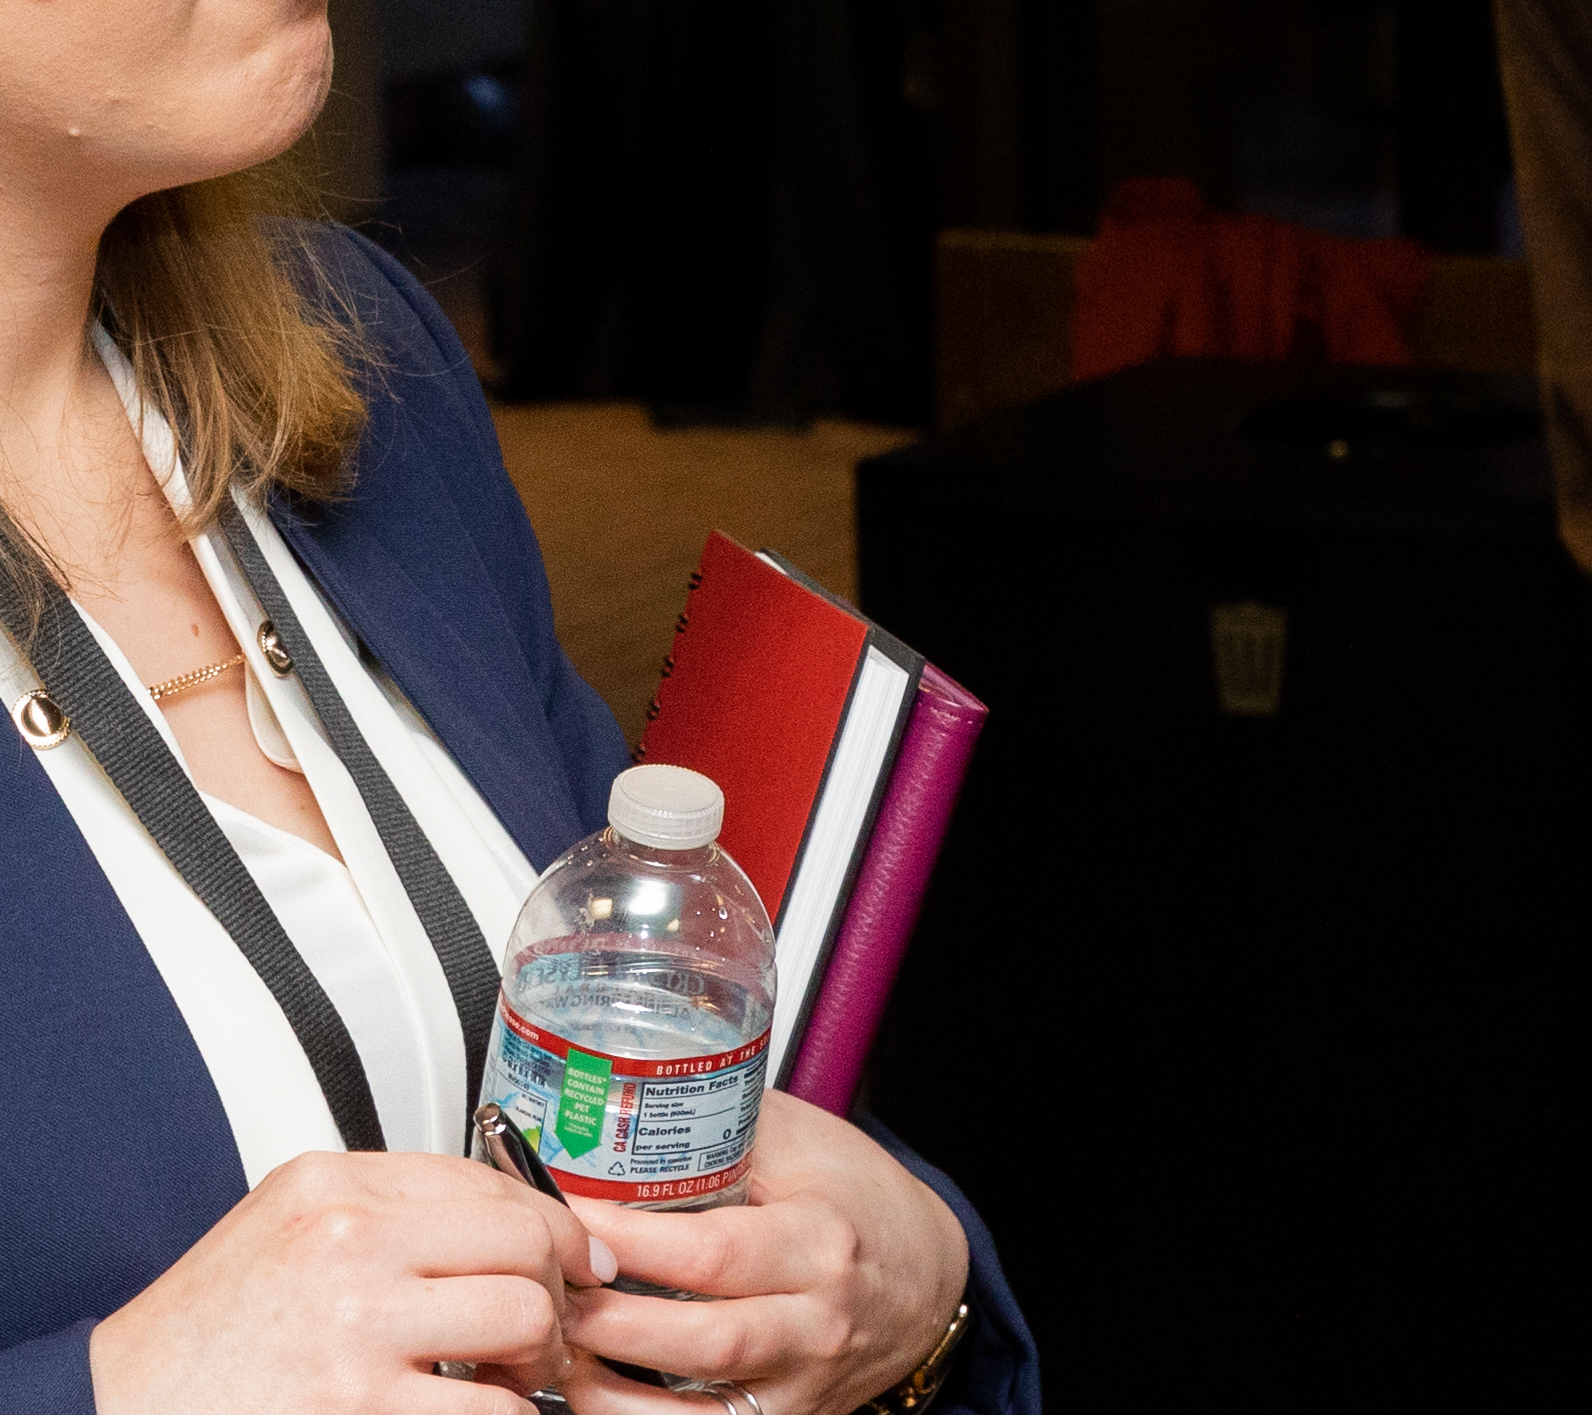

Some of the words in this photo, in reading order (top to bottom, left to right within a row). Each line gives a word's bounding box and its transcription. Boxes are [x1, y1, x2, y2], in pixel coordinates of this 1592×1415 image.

[656, 1061, 712, 1076] BOTTLED
[719, 1056, 734, 1069] AT
[740, 1047, 756, 1061] THE
[566, 1079, 605, 1095] CONTAIN
[645, 1084, 705, 1096] Nutrition
[709, 1074, 739, 1091] Facts
[564, 1089, 604, 1106] RECYCLED
[620, 1082, 637, 1115] REFUND
[574, 1102, 590, 1113] PET
[644, 1102, 669, 1110] Serving
[564, 1110, 597, 1126] PLASTIC
[614, 1116, 631, 1139] CASH
[638, 1126, 691, 1136] Calories
[722, 1128, 732, 1140] 0
[612, 1141, 627, 1153] CA
[636, 1143, 652, 1152] per
[655, 1141, 690, 1151] serving
[630, 1165, 658, 1174] PLEASE
[660, 1164, 690, 1173] RECYCLE
[637, 1185, 660, 1197] 16.9
[662, 1184, 674, 1197] FL
[678, 1180, 694, 1195] OZ
[696, 1175, 721, 1191] (1.06
